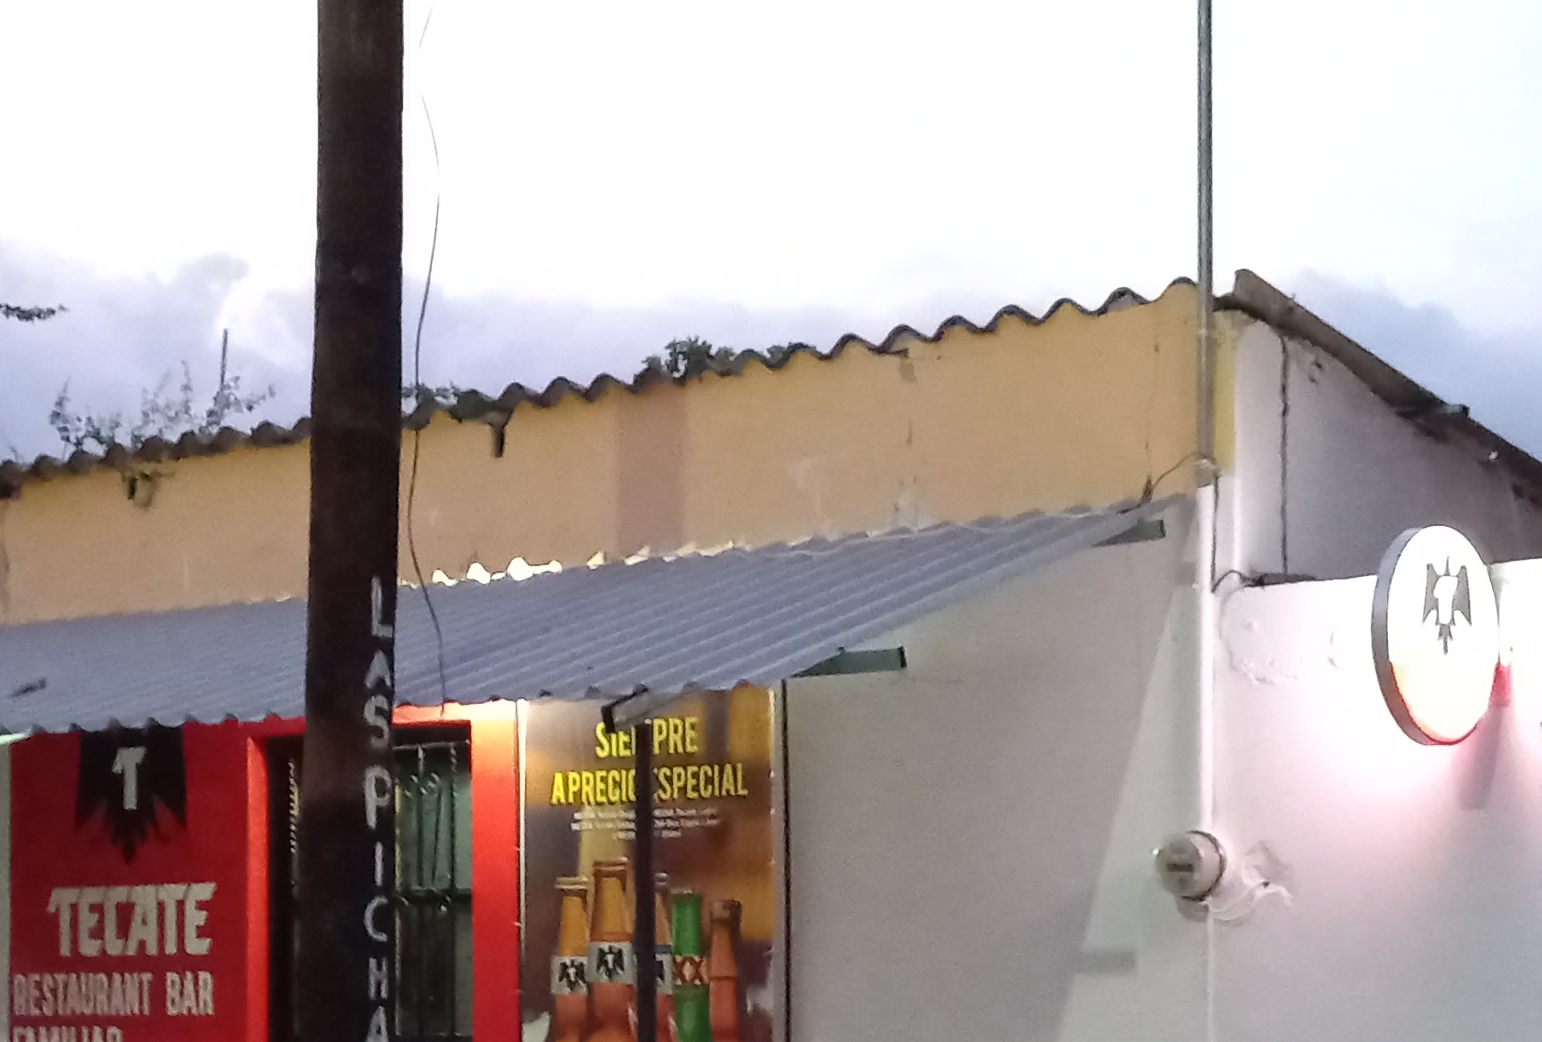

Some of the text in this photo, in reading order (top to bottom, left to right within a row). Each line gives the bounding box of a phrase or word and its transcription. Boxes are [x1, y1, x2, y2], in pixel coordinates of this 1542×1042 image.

[364, 575, 394, 756] LAS
[595, 716, 699, 758] SIEPRE
[112, 746, 147, 811] T
[652, 762, 749, 803] SPECIAL
[47, 882, 217, 957] TECATE
[12, 970, 215, 1016] RESTAURANT BAR
